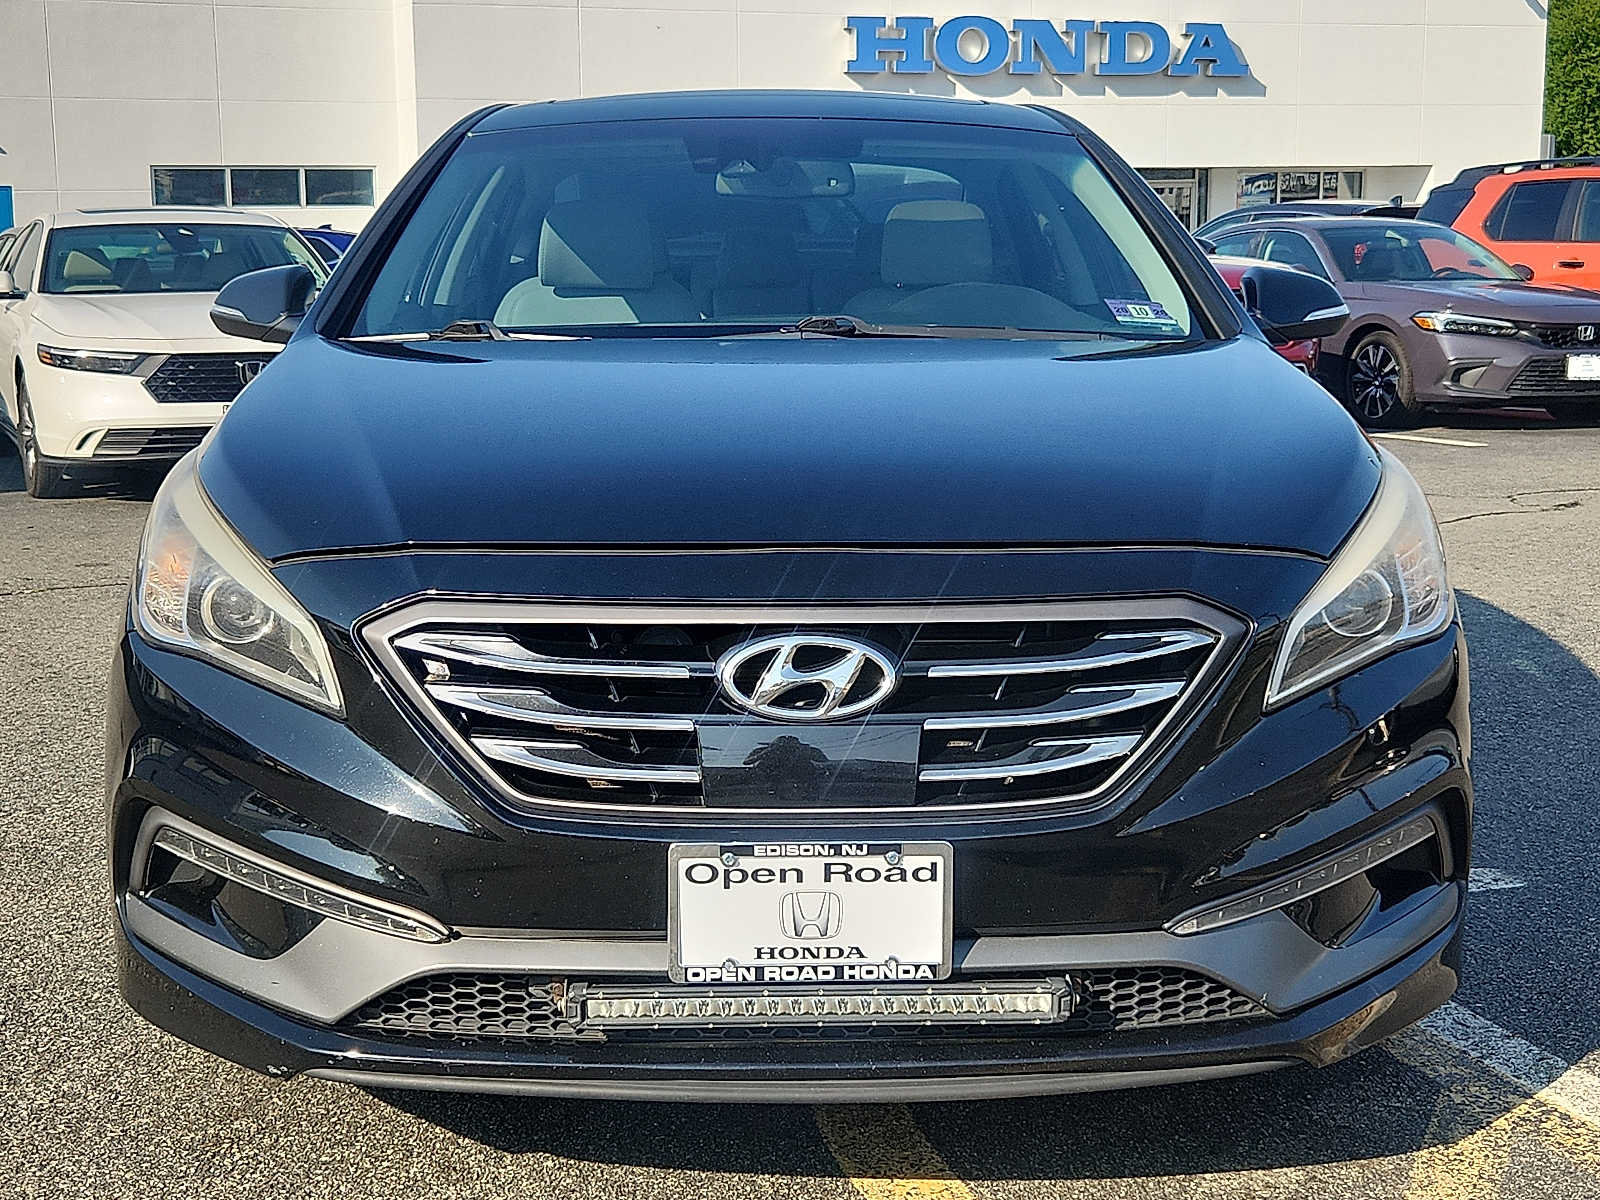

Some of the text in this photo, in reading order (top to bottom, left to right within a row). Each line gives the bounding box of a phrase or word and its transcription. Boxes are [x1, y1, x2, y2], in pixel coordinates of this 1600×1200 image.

[845, 15, 1250, 78] HONDA
[1132, 306, 1149, 317] 10
[753, 844, 869, 857] EDISON, NJ
[685, 861, 938, 889] Open Road
[753, 946, 868, 960] HONDA
[686, 965, 936, 983] OPEN ROAD HONDA
